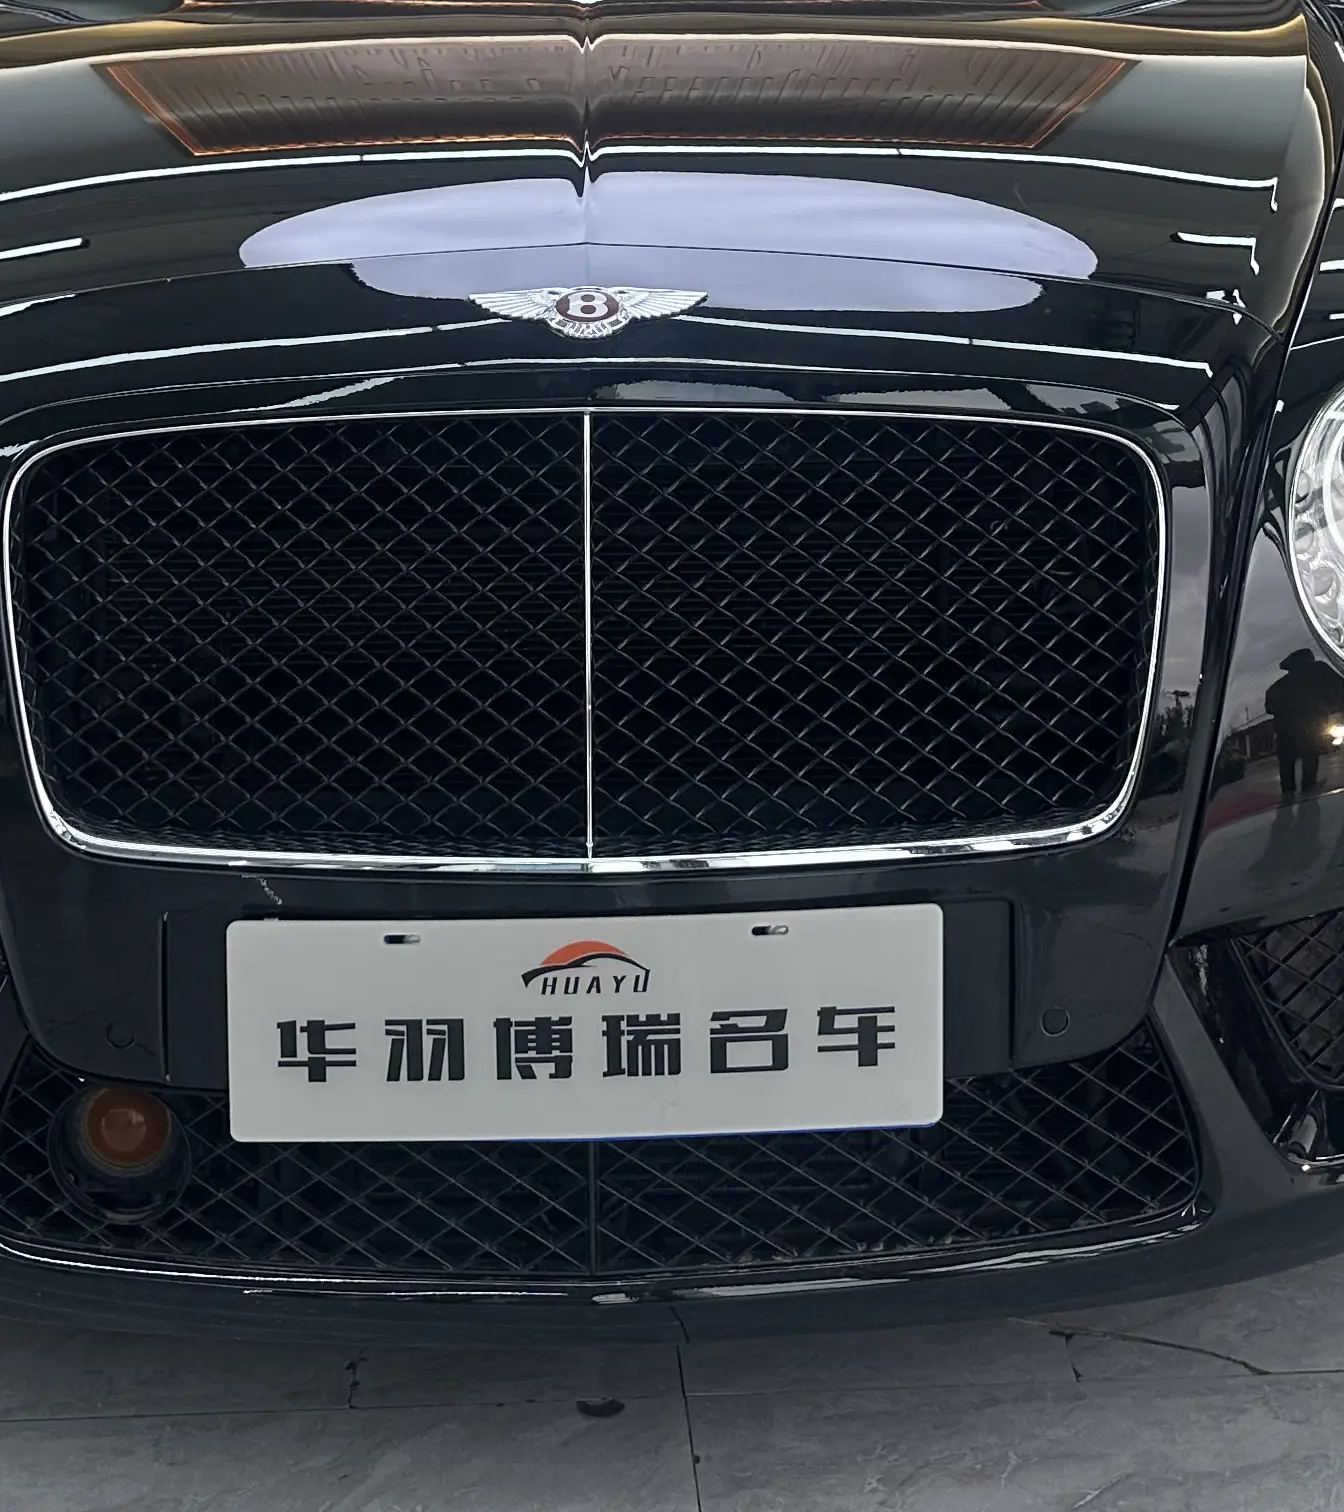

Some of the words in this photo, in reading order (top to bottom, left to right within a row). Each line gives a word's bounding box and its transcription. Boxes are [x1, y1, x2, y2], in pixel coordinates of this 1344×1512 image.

[567, 291, 608, 317] B
[540, 972, 651, 997] HUAYU
[276, 1005, 897, 1084] 华羽博瑞名车
